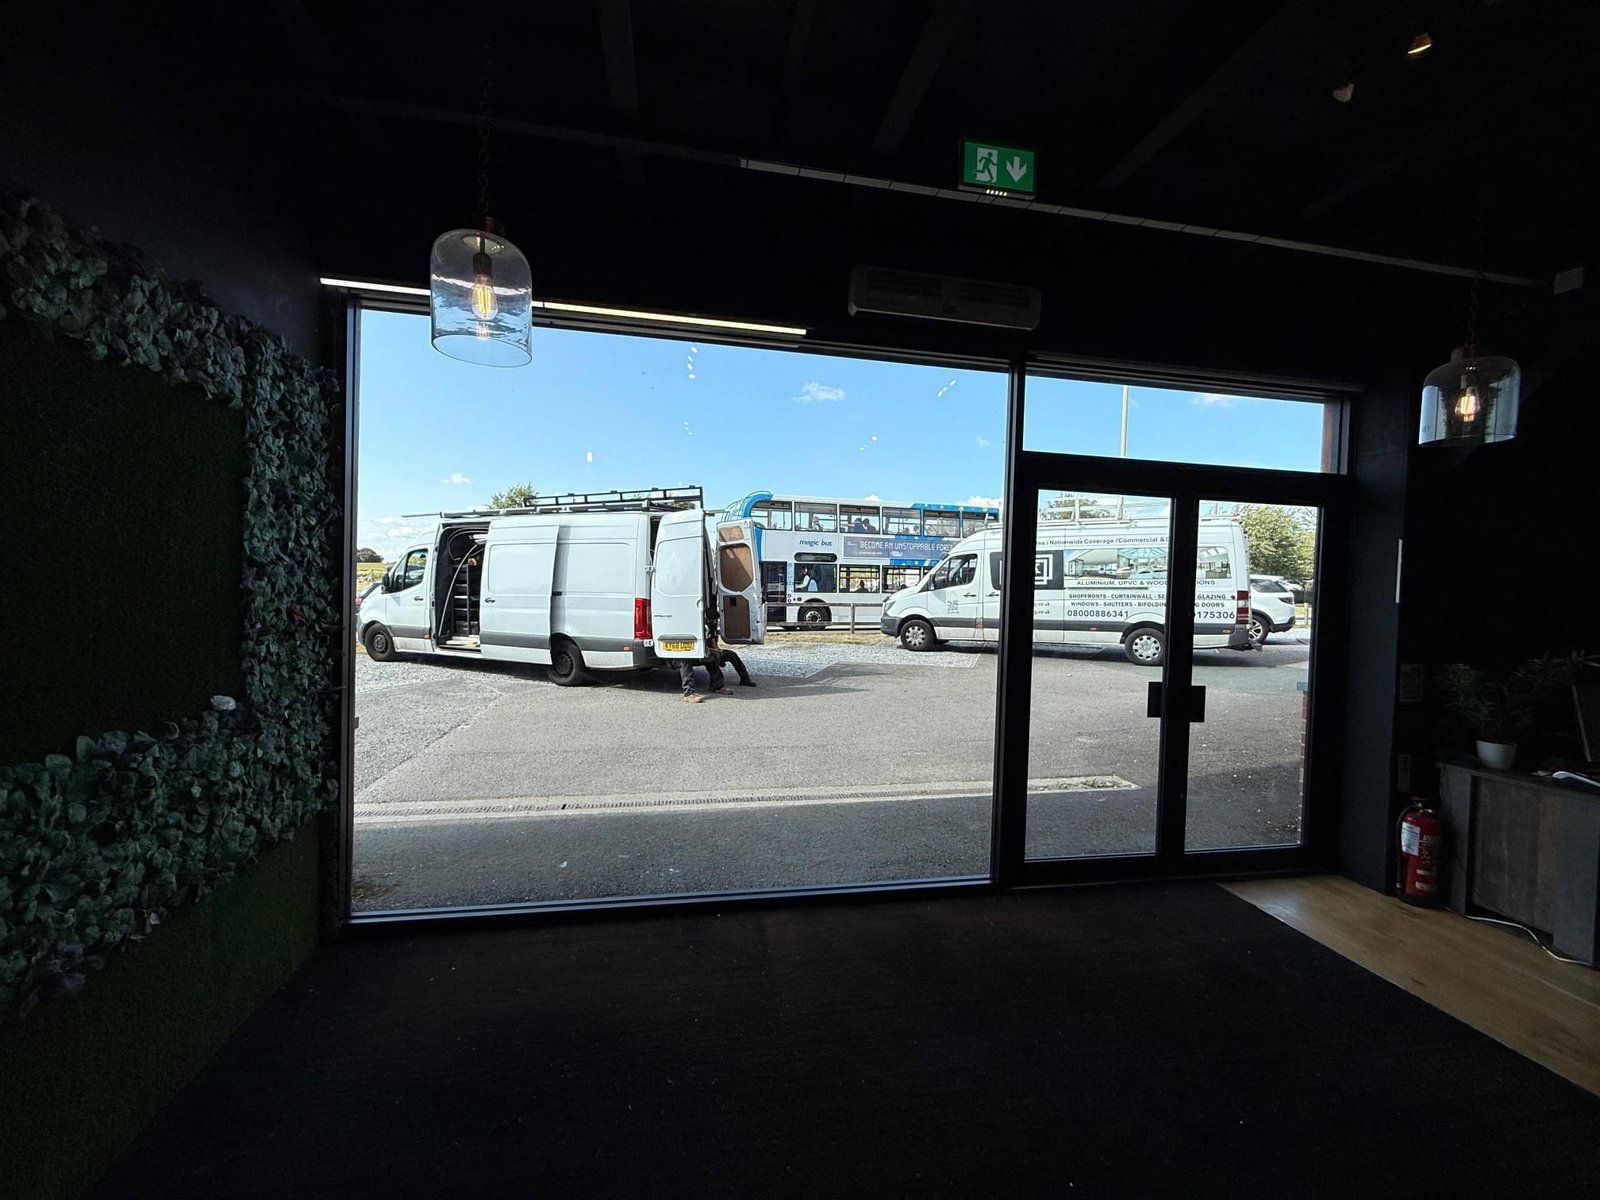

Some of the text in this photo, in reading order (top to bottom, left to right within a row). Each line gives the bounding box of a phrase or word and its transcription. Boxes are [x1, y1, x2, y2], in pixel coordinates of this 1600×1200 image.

[820, 539, 833, 547] bus
[860, 540, 884, 550] BECOME
[894, 542, 935, 551] UNSTOPPABLE
[1084, 538, 1114, 546] Coverage
[1067, 609, 1129, 617] 08000886341
[1196, 611, 1236, 619] 175306
